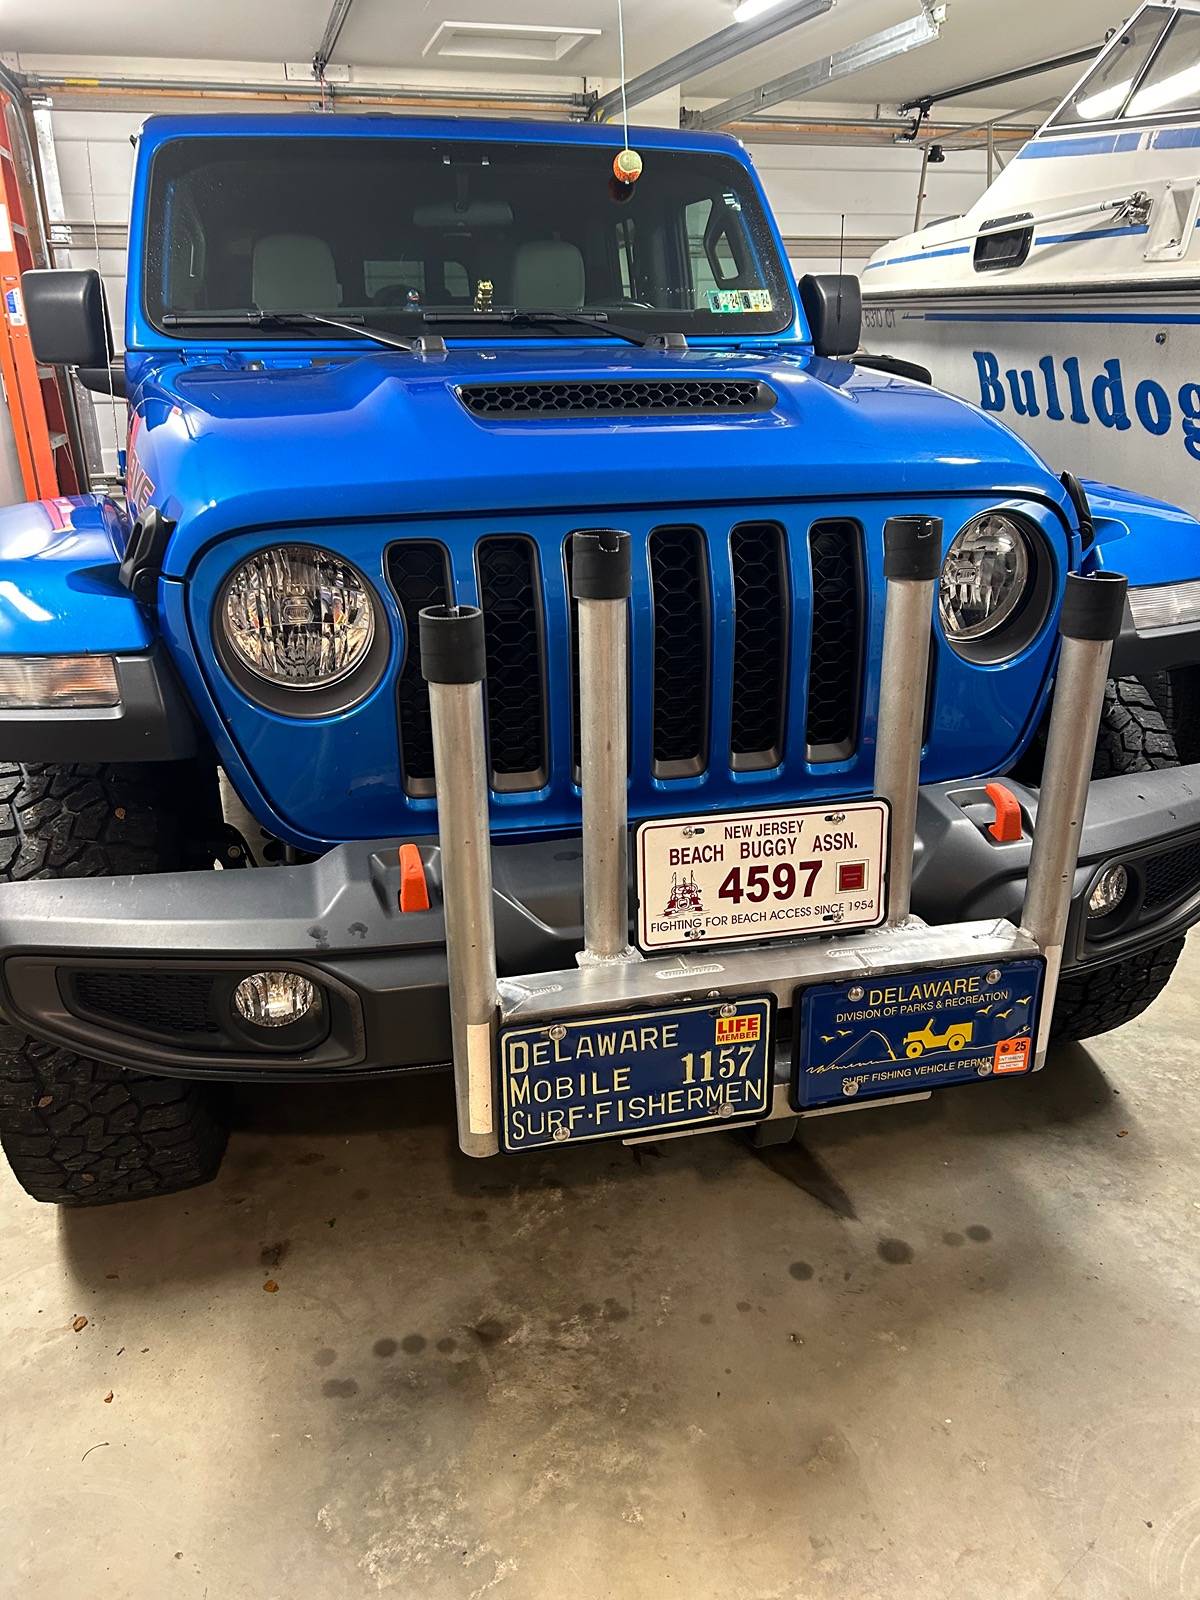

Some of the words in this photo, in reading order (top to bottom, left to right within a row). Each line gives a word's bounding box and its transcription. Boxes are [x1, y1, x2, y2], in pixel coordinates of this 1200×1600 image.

[972, 351, 1200, 462] Bulldog
[724, 823, 755, 840] NEW
[756, 820, 805, 837] JERSEY
[669, 843, 724, 866] BEACH
[740, 837, 798, 860] BUGGY
[812, 832, 858, 852] ASSN.
[718, 860, 823, 905] 4597
[650, 917, 703, 933] FIGHTING
[705, 915, 729, 928] FOR
[731, 911, 767, 925] BEACH
[769, 907, 812, 921] ACCESS
[814, 902, 845, 915] SINCE
[848, 899, 874, 912] 1954
[836, 1009, 882, 1023] DIVISION
[883, 1007, 898, 1017] OF
[900, 1002, 934, 1014] PARKS
[936, 1000, 943, 1011] &
[945, 991, 1009, 1008] RECREATION
[869, 975, 981, 1006] DELAWARE
[717, 1031, 758, 1042] MEMBER
[718, 1017, 759, 1034] LIFE
[509, 1023, 679, 1075] DELAWARE
[1014, 1040, 1027, 1052] 25
[680, 1044, 757, 1085] 1157
[842, 1072, 870, 1086] SURF
[872, 1067, 912, 1082] FISHING
[914, 1061, 956, 1077] VEHICLE
[957, 1055, 994, 1071] PERMIT
[510, 1067, 631, 1108] MOBILE
